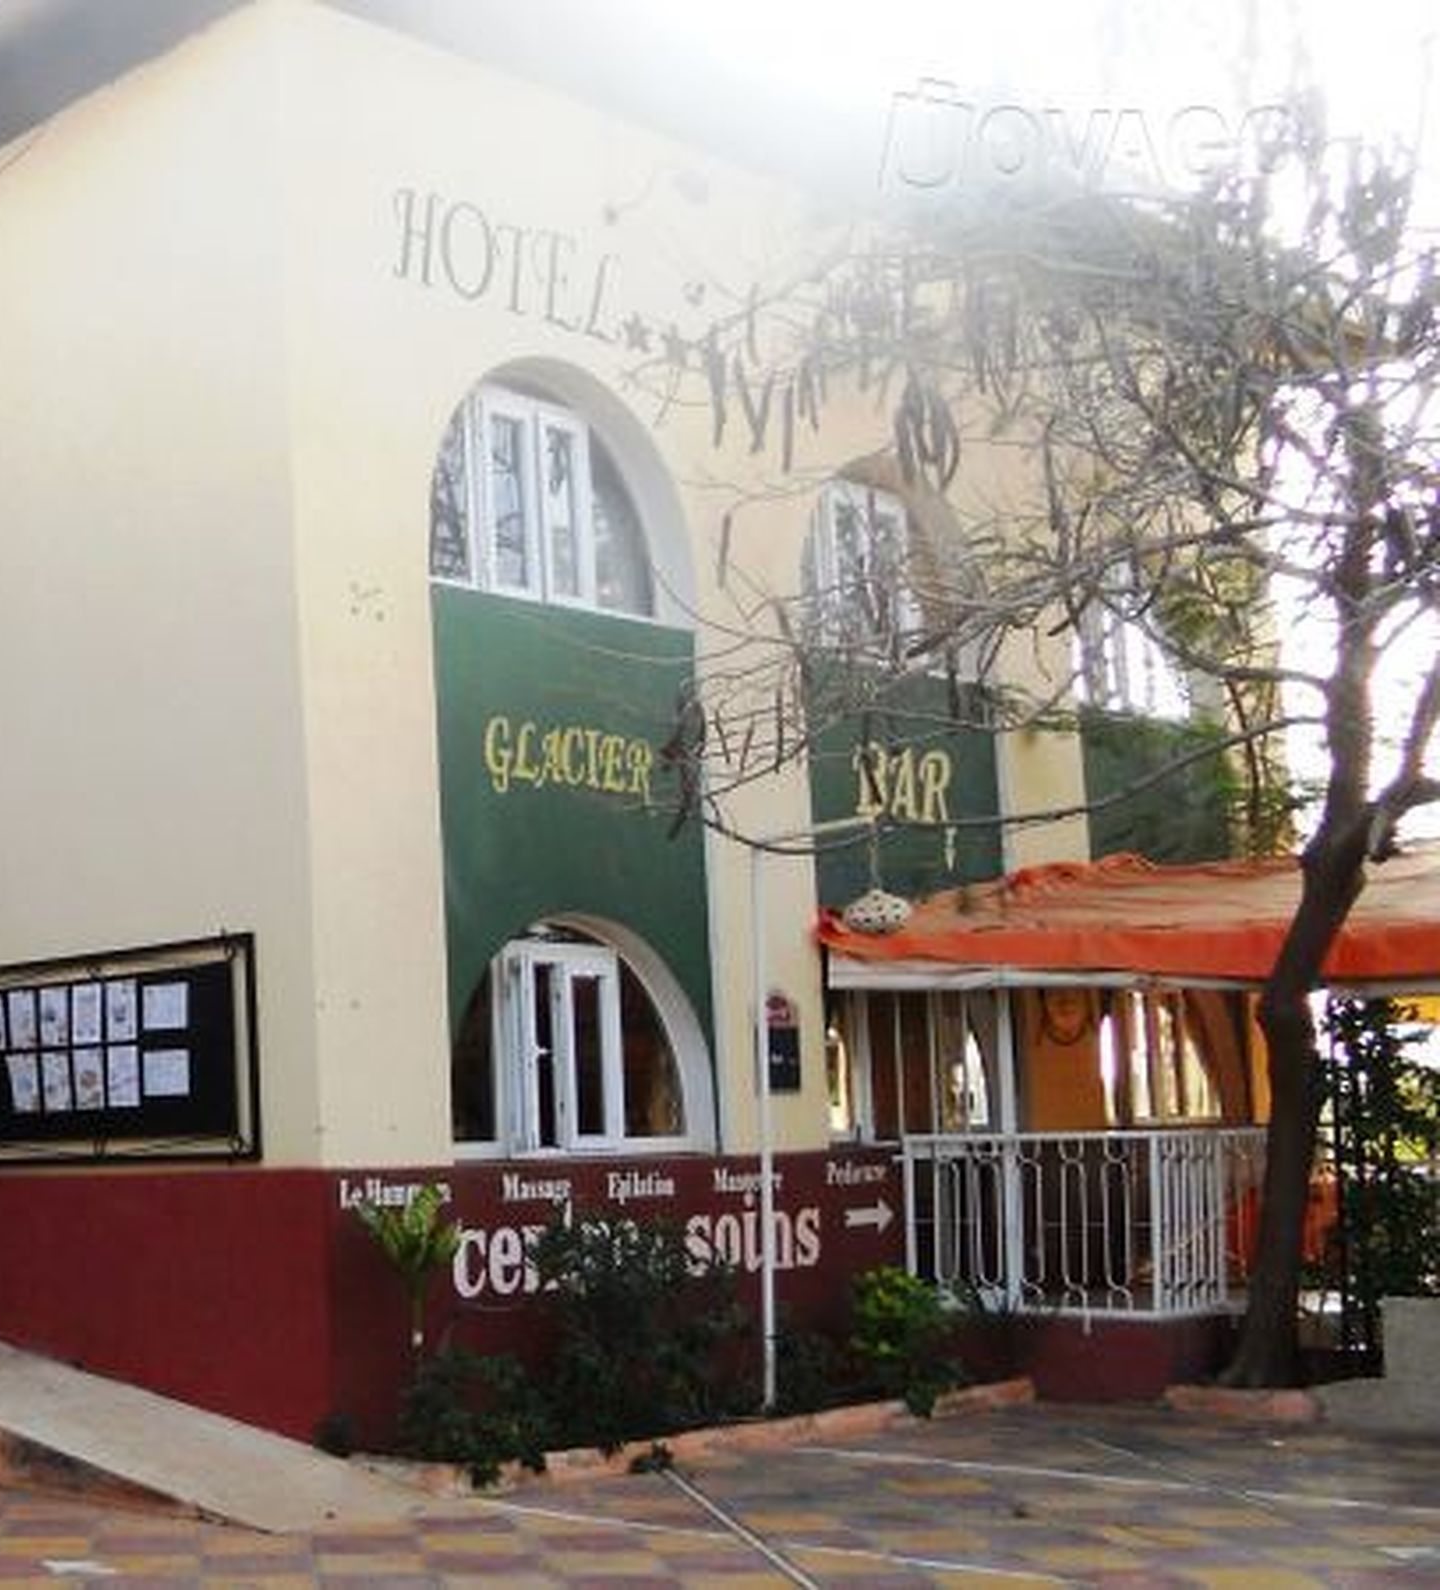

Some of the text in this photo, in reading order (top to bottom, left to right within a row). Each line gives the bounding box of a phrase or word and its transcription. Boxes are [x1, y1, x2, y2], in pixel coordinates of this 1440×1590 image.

[393, 188, 622, 345] HOTEL
[484, 715, 654, 806] GLACIER
[852, 740, 957, 872] BAR
[685, 1193, 821, 1277] soins
